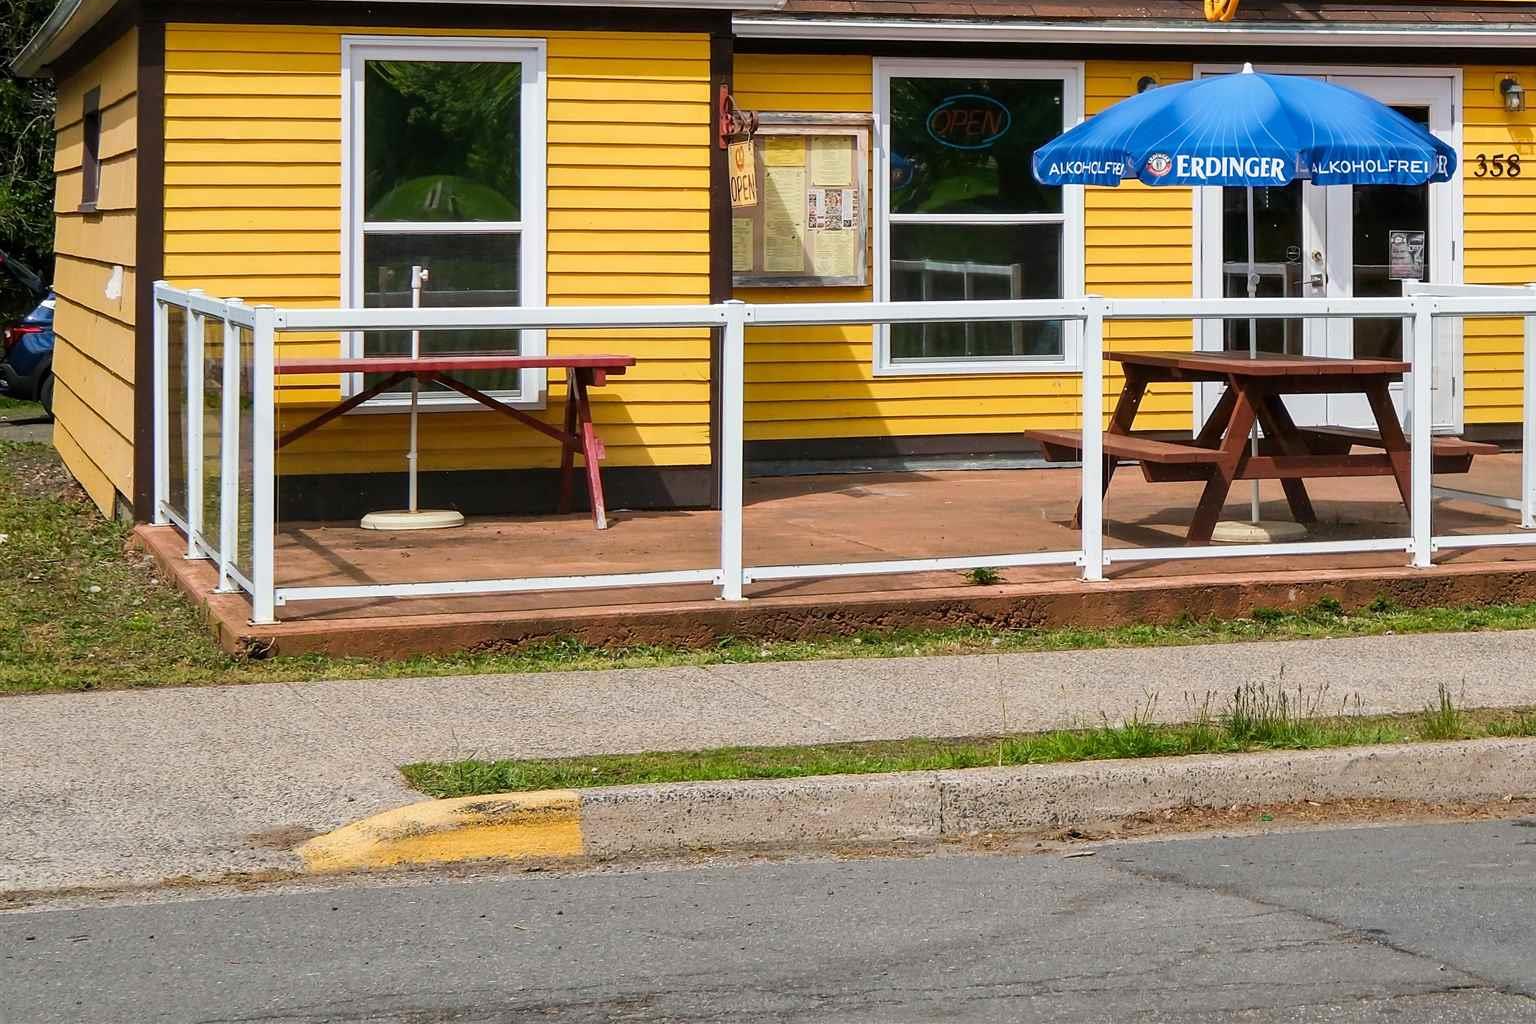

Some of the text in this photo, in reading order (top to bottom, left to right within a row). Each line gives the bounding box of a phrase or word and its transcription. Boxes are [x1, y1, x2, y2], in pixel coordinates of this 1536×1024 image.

[930, 109, 1003, 136] OPEN
[1176, 154, 1286, 182] ERDINGER
[1311, 159, 1429, 175] ALKOHOLFREI
[1474, 154, 1521, 178] 358
[730, 173, 756, 202] OPEN
